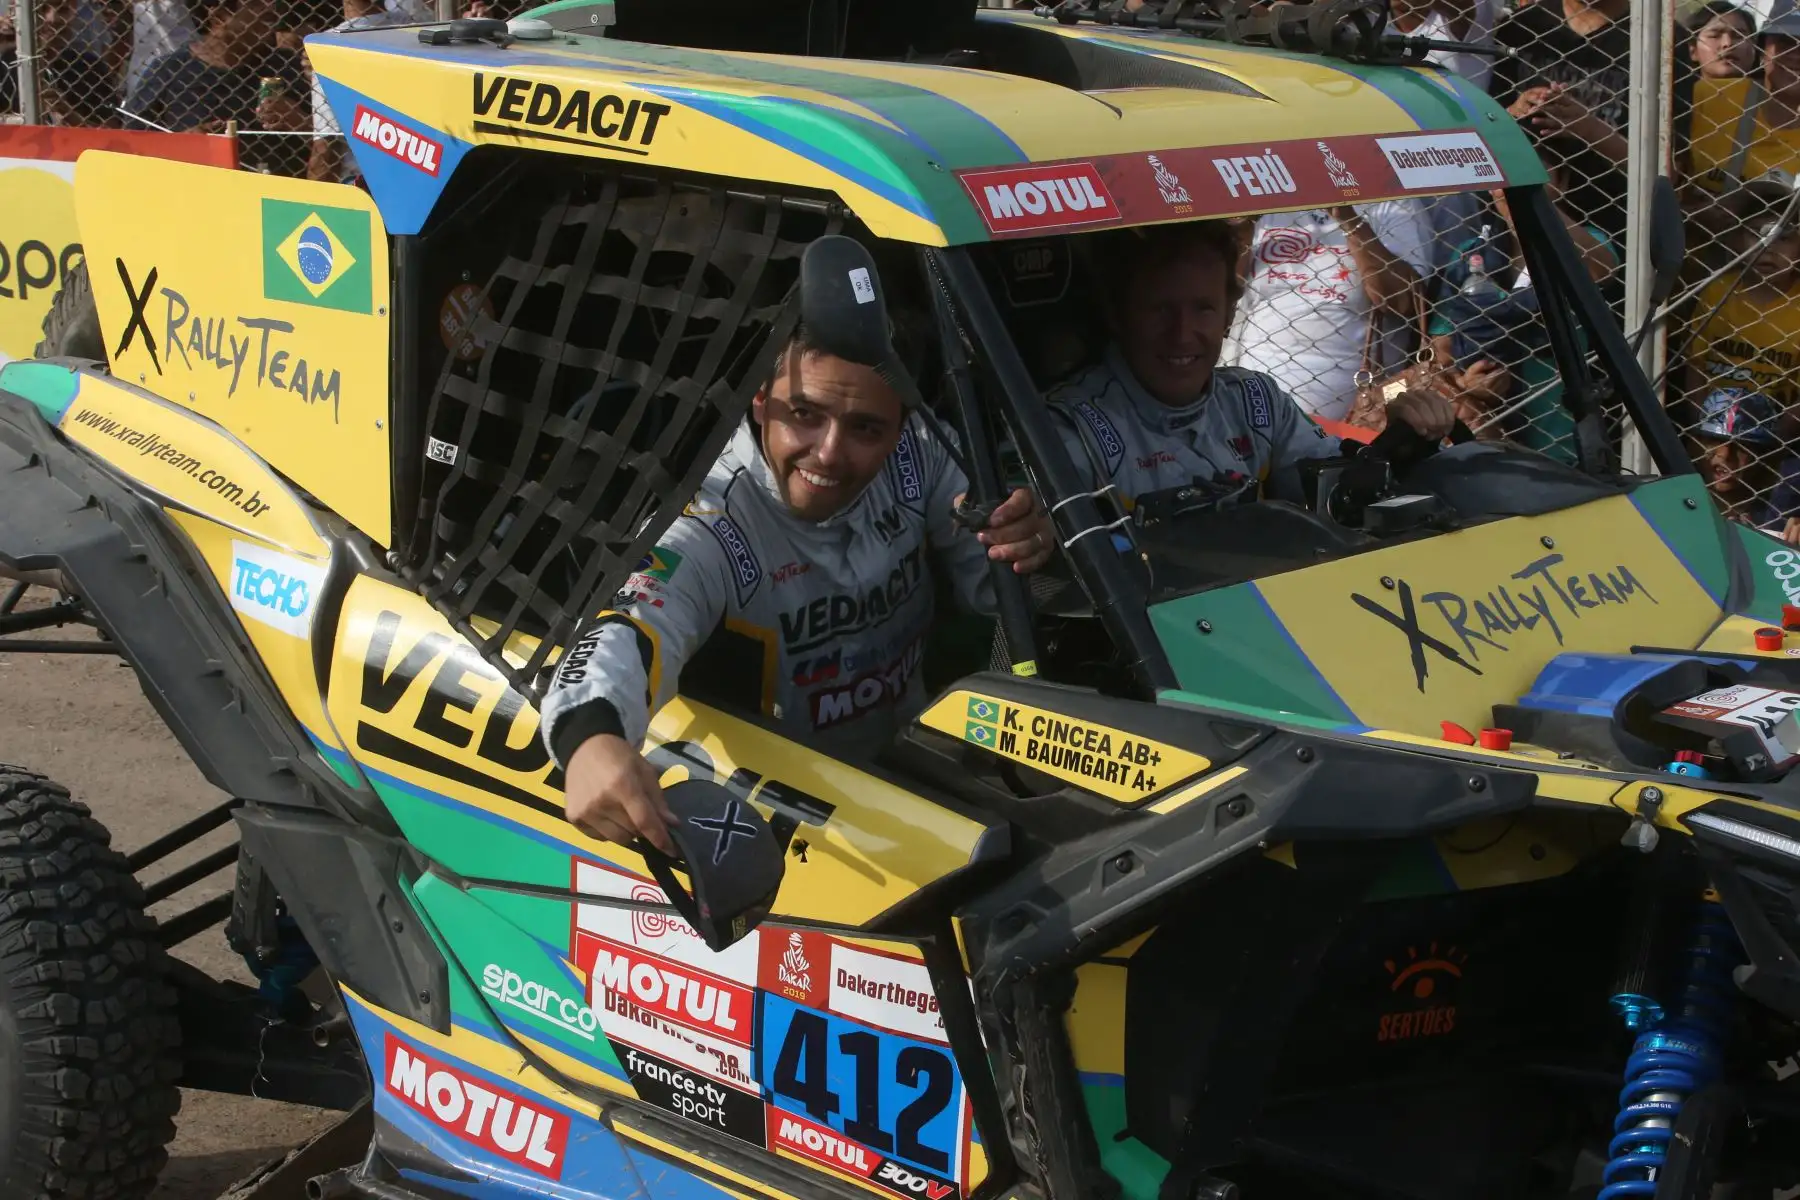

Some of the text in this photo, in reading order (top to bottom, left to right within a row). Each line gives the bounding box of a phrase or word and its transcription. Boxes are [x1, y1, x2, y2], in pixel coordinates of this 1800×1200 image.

[473, 73, 671, 145] VEDACIT
[356, 112, 436, 171] MOTUL
[1390, 147, 1488, 168] Dakarthegame
[1473, 164, 1496, 177] .com
[983, 176, 1106, 219] MOTUL
[1212, 148, 1297, 197] PERÚ
[1174, 204, 1193, 214] 2019
[74, 408, 270, 517] www.xrallyteam.com.br
[720, 520, 756, 581] sparco
[236, 558, 311, 618] TECHO
[999, 731, 1157, 791] M. BAUMGART A+
[1003, 706, 1162, 767] K. CINCEA AB+
[482, 963, 597, 1034] sparco
[592, 949, 737, 1031] MOTUL
[778, 964, 812, 993] DAKAR
[783, 985, 806, 1000] 2019
[390, 1046, 556, 1168] MOTUL
[672, 1092, 727, 1127] sport
[773, 1008, 954, 1174] 412
[779, 1118, 954, 1200] MOTUL 300V
